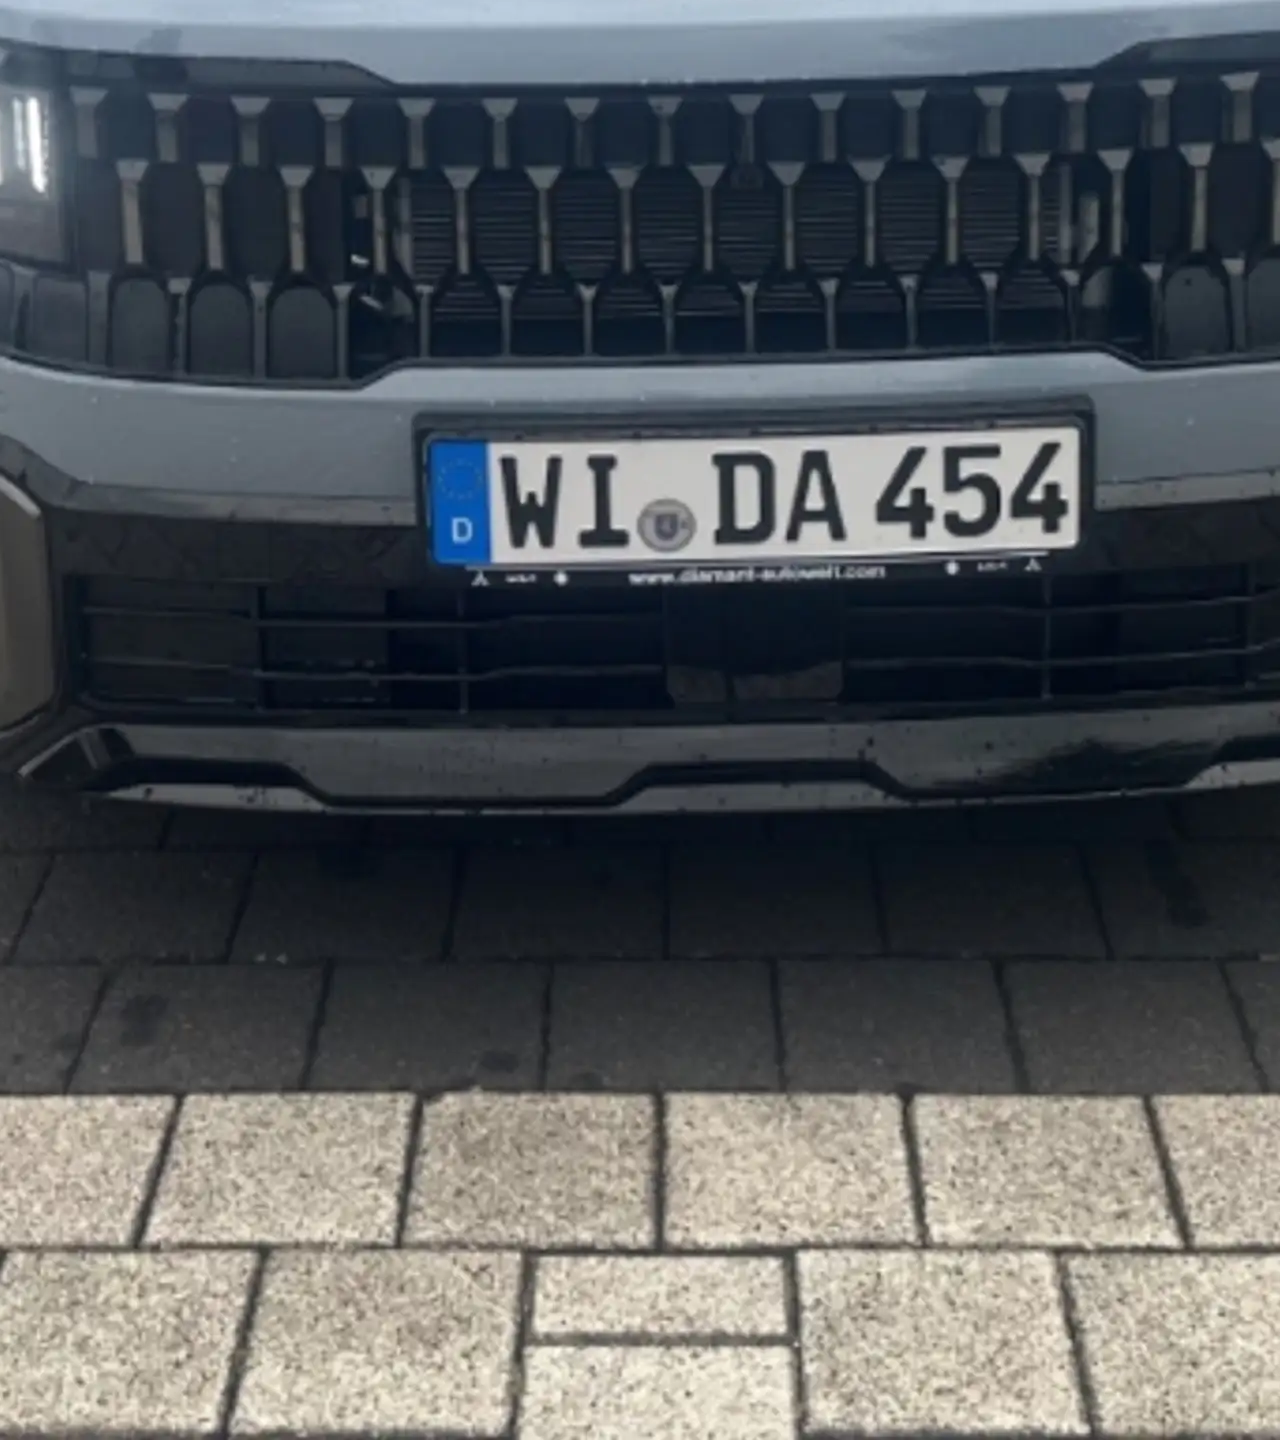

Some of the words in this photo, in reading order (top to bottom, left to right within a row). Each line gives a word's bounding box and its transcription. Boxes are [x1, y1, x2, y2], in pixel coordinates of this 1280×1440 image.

[499, 455, 630, 549] WI
[712, 450, 847, 546] DA
[875, 441, 1070, 541] 454
[451, 516, 474, 544] D
